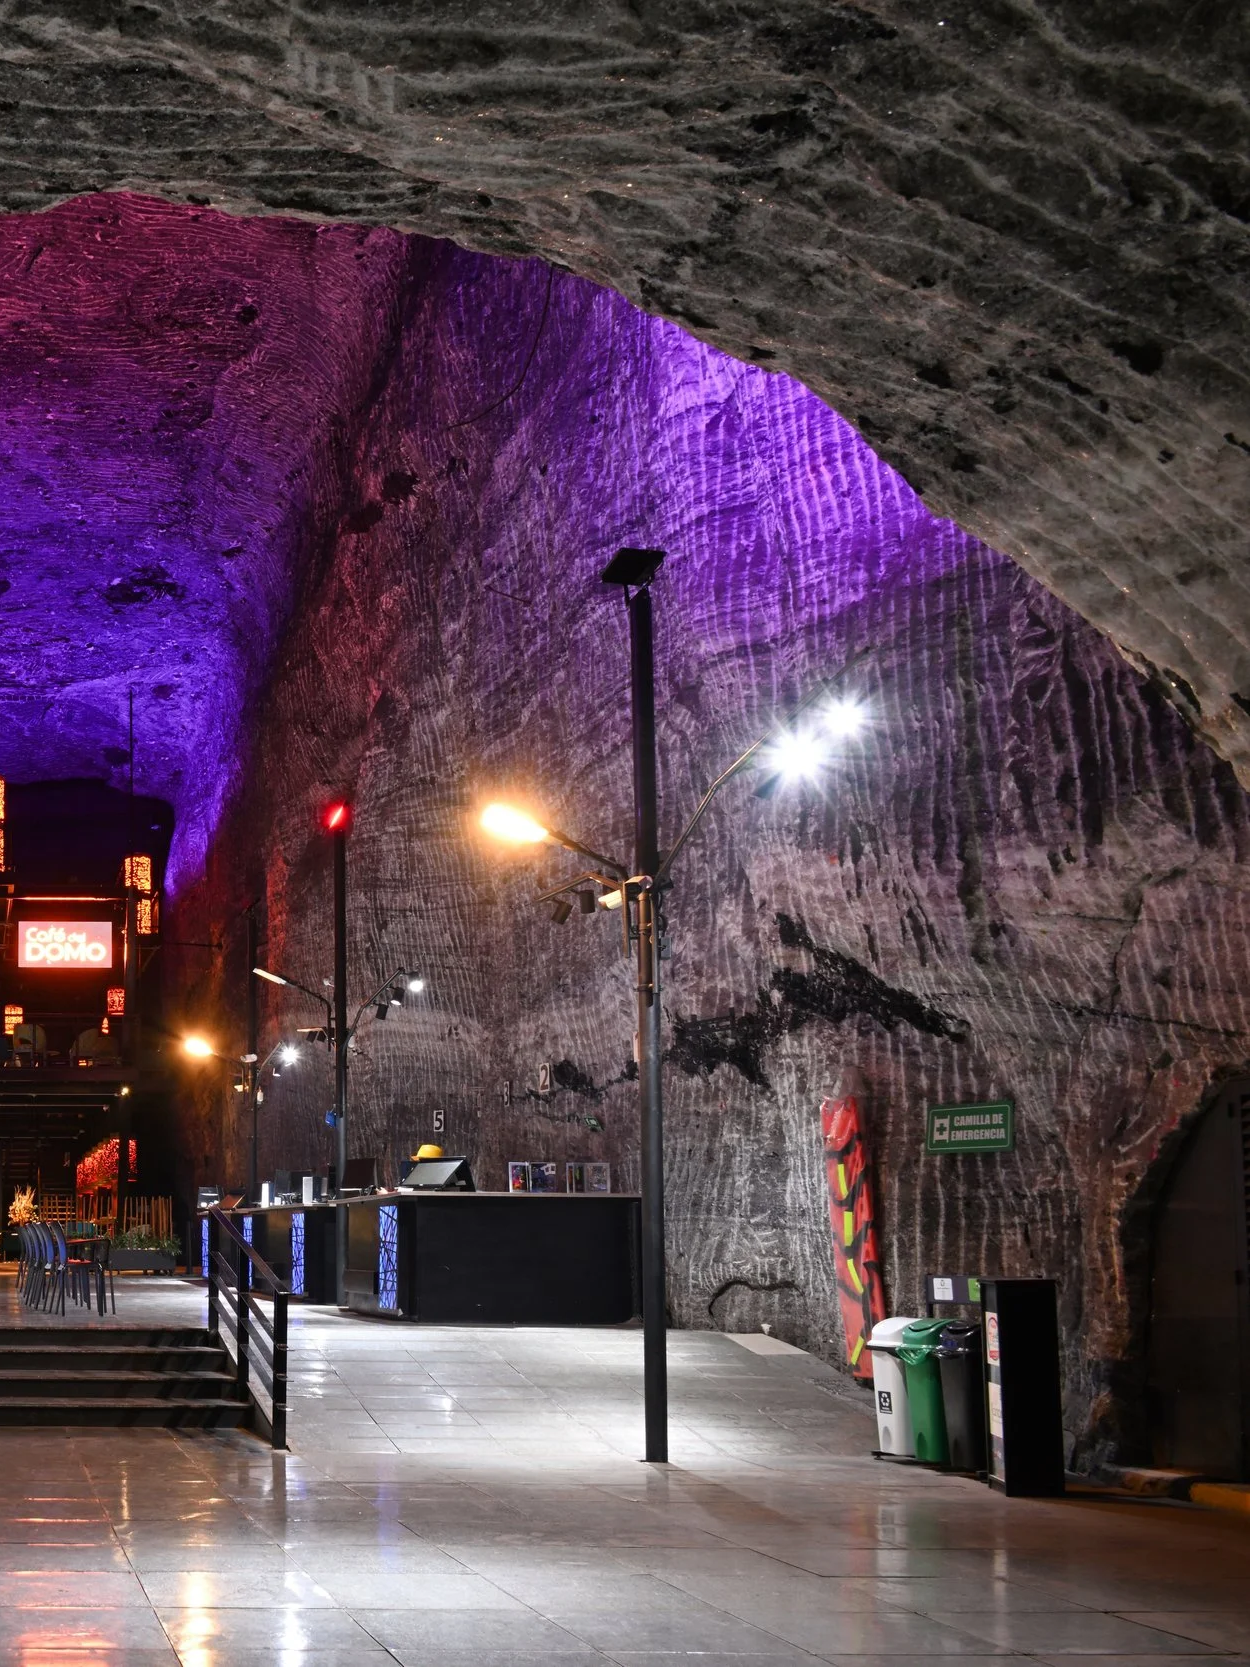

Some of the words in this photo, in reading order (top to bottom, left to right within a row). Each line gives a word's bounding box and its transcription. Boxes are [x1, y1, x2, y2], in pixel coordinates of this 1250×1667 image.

[25, 941, 107, 962] DOMO
[540, 1064, 549, 1091] 2
[434, 1111, 443, 1131] 5
[954, 1114, 990, 1127] CAMILLA
[992, 1113, 1004, 1125] DE
[951, 1128, 1006, 1141] EMERGENCIA
